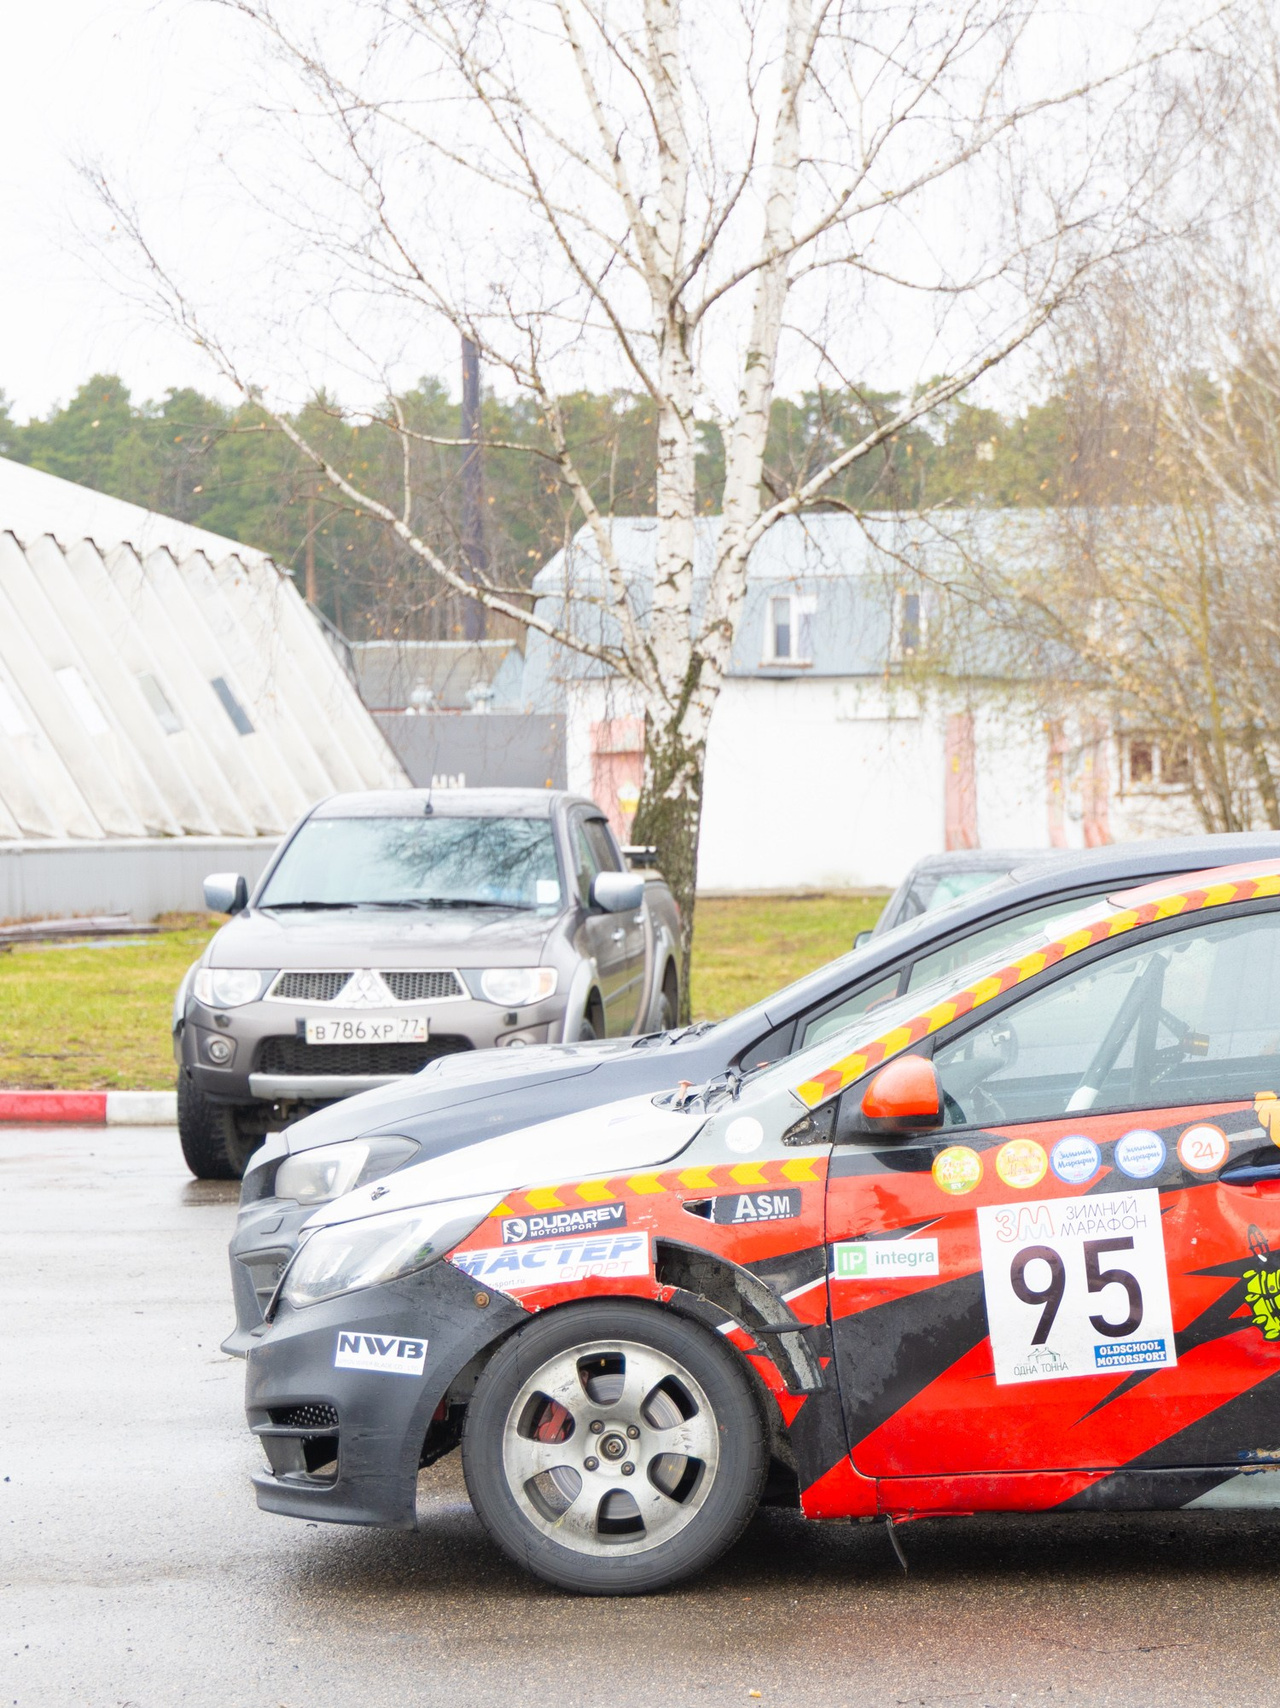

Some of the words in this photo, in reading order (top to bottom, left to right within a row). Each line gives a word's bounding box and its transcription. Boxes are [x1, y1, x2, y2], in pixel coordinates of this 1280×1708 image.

[401, 1019, 418, 1033] 77
[735, 1194, 791, 1218] ASM
[1066, 1196, 1138, 1220] ЗИМНИЙ
[530, 1205, 624, 1230] DUDAREV
[1060, 1215, 1148, 1237] МАРАФОН
[530, 1222, 599, 1237] MOTORSPORT
[843, 1252, 863, 1271] IP
[876, 1251, 935, 1268] integra
[1010, 1236, 1144, 1346] 95
[339, 1334, 424, 1359] NWB
[1099, 1341, 1161, 1355] OLDSCHOOL
[1014, 1364, 1037, 1376] ОДНА
[1041, 1362, 1069, 1374] ТОННА
[1097, 1351, 1167, 1367] MOTORSPORT
